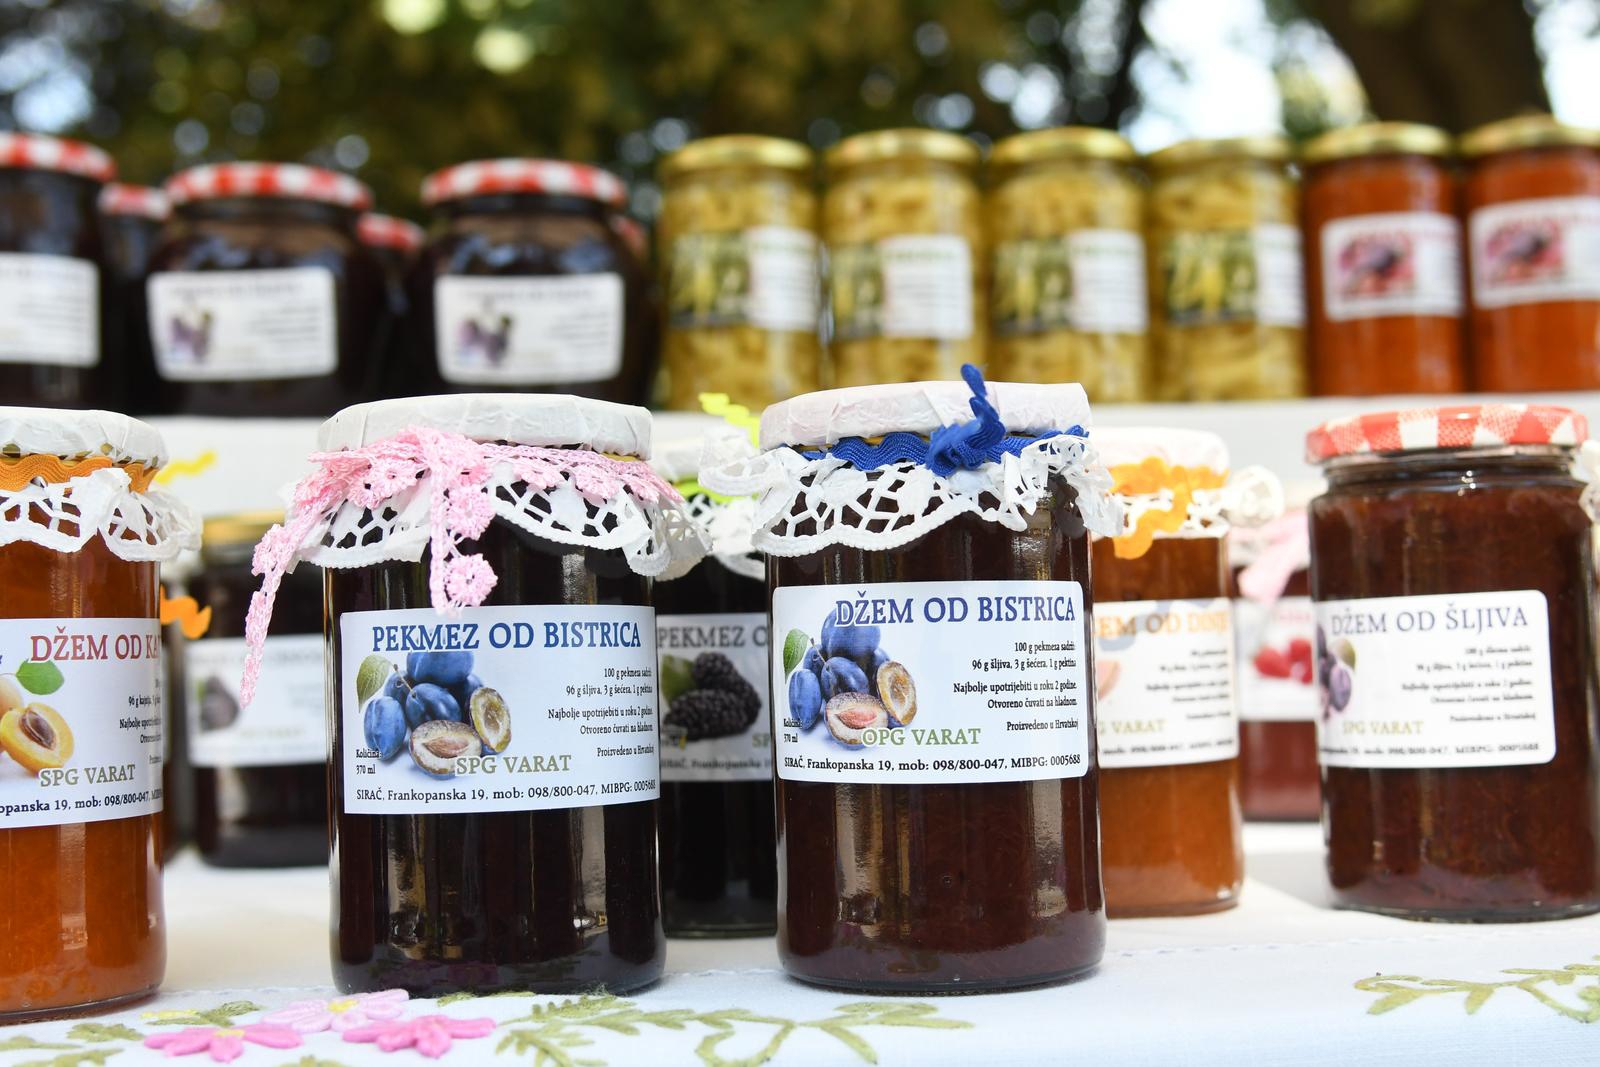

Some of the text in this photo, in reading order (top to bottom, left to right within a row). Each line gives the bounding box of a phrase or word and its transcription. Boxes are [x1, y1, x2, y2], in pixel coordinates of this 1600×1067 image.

[836, 590, 1076, 626] DŽEM OD BISTRICA
[1331, 608, 1387, 636] DŽEM
[1396, 610, 1436, 632] OD
[1446, 602, 1529, 634] ŠLJIVA
[30, 626, 108, 662] DŽEM
[114, 634, 142, 660] OD
[372, 622, 642, 652] PEKMEZ OD BISTRICA
[658, 626, 745, 649] PEKMEZ
[1015, 642, 1027, 652] 100
[1029, 645, 1033, 654] g
[1034, 641, 1059, 654] pekmeza
[604, 668, 614, 677] 100
[616, 670, 620, 680] g
[620, 666, 640, 680] pekmeza
[972, 659, 982, 670] 96
[984, 663, 989, 672] g
[990, 658, 1013, 671] šljiva,
[1014, 659, 1019, 669] 3
[1020, 662, 1025, 671] g
[1026, 659, 1048, 669] šećera,
[1054, 660, 1058, 671] g
[566, 685, 576, 696] 96
[577, 688, 581, 698] g
[604, 684, 608, 695] 3
[609, 687, 613, 697] g
[953, 682, 988, 695] Najbolje
[990, 680, 1033, 695] upotrijebiti
[1039, 680, 1054, 690] roku
[1055, 681, 1059, 690] 2
[987, 699, 1023, 709] Otvoreno
[1025, 698, 1045, 708] čuvati
[1046, 699, 1053, 707] na
[547, 707, 580, 721] Najbolje
[581, 706, 619, 720] upotrijebiti
[625, 705, 637, 716] roku
[580, 725, 612, 734] Otvoreno
[613, 724, 630, 733] čuvati
[1006, 719, 1049, 731] Proizvedeno
[1055, 717, 1079, 730] Hrvatskoj
[862, 728, 981, 746] OPG VARAT
[597, 745, 632, 757] Proizvedeno
[356, 764, 376, 775] 370 ml
[456, 754, 572, 775] SPG VARAT
[784, 754, 1081, 772] SIRAČ, Frankopanska 19, mob: 098/800-047, MIBPG: 0005688
[40, 764, 136, 788] SPG VARAT
[54, 799, 71, 811] 19,
[74, 796, 102, 810] mob:
[104, 790, 150, 806] 098/800-047,
[356, 787, 385, 801] SIRAČ,
[388, 788, 467, 804] Frankopanska
[471, 789, 489, 800] 19,
[493, 787, 524, 800] mob:
[528, 785, 598, 799] 098/800-047,
[601, 782, 632, 794] MIBPG:
